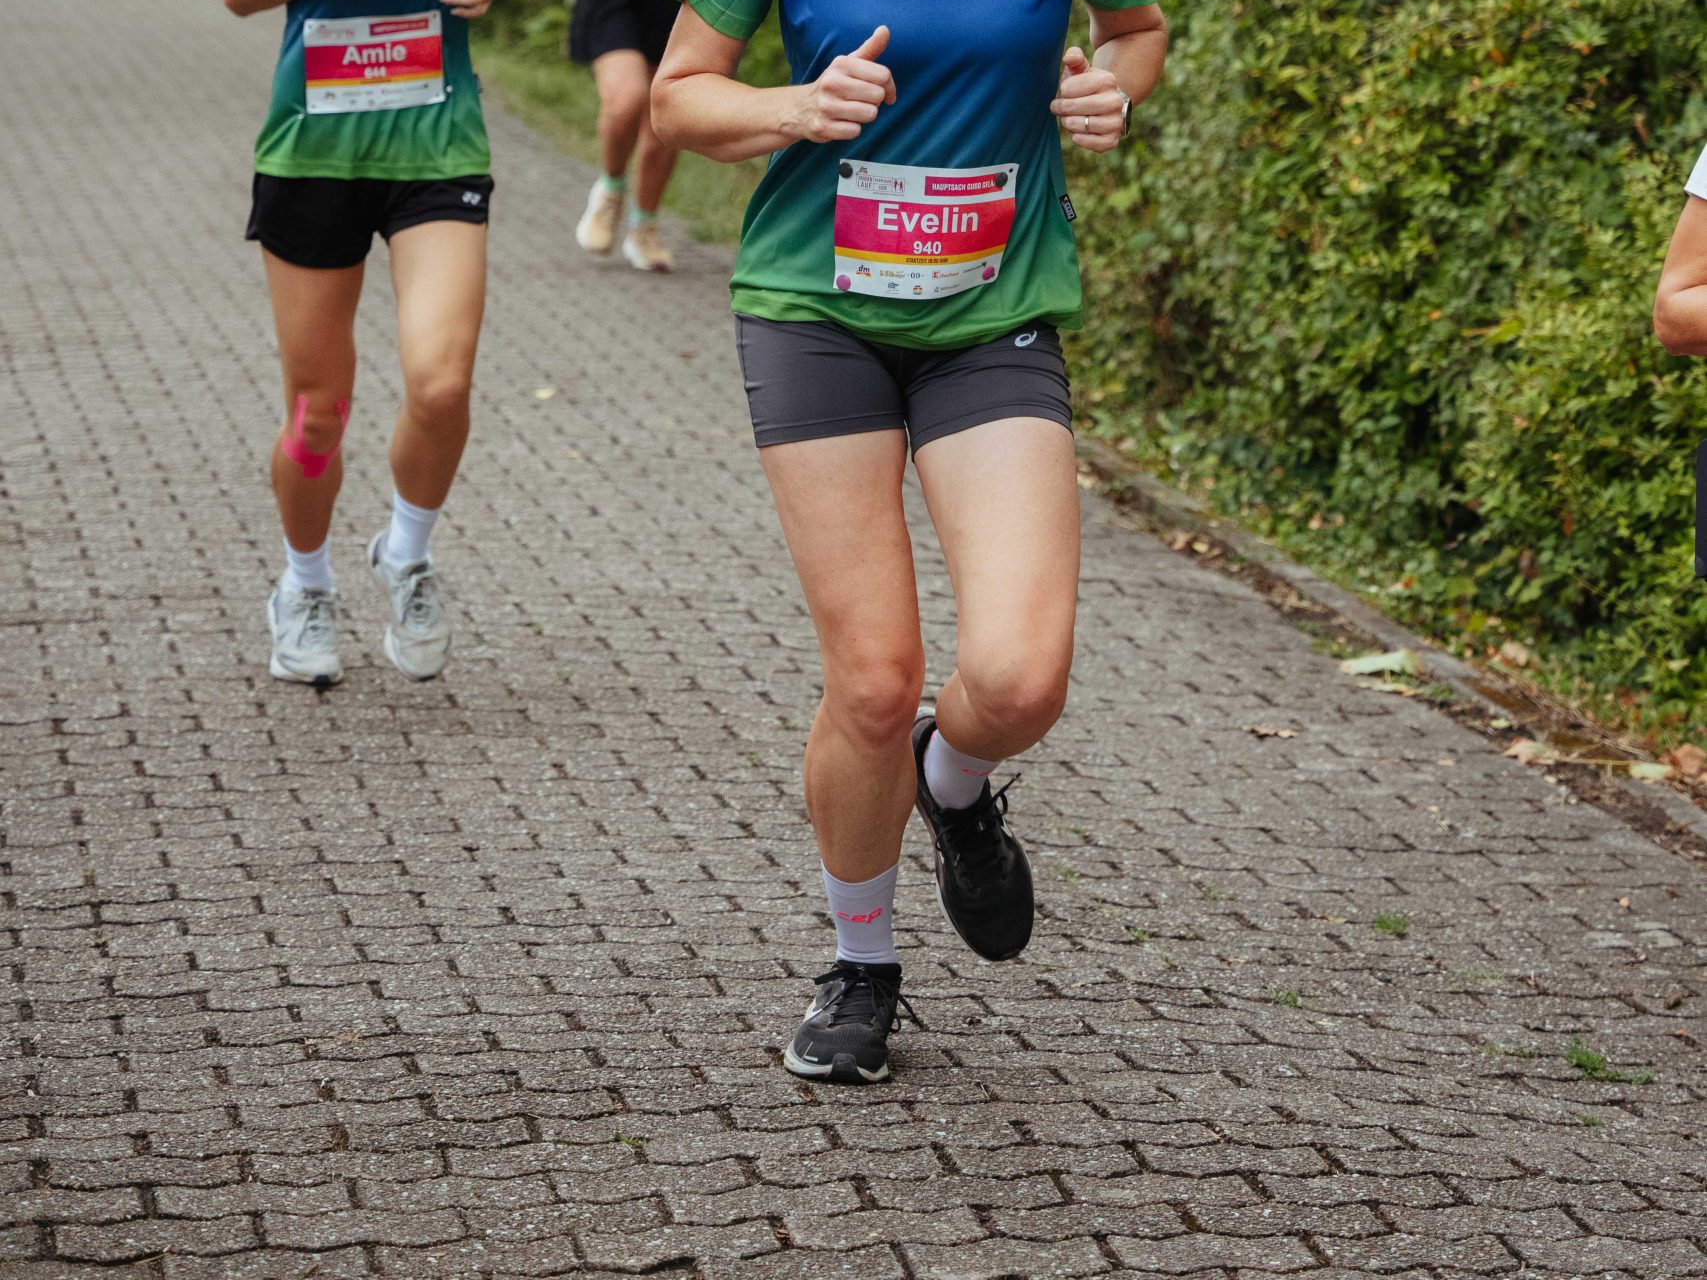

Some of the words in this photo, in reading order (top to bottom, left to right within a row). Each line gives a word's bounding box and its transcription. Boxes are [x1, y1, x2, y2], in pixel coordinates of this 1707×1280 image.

[341, 42, 407, 66] Amie
[857, 181, 872, 189] LAUF
[932, 183, 966, 191] HAUPTSACH
[877, 202, 979, 234] Evelin
[913, 241, 942, 255] 940
[858, 265, 870, 273] dm
[837, 907, 883, 924] cep
